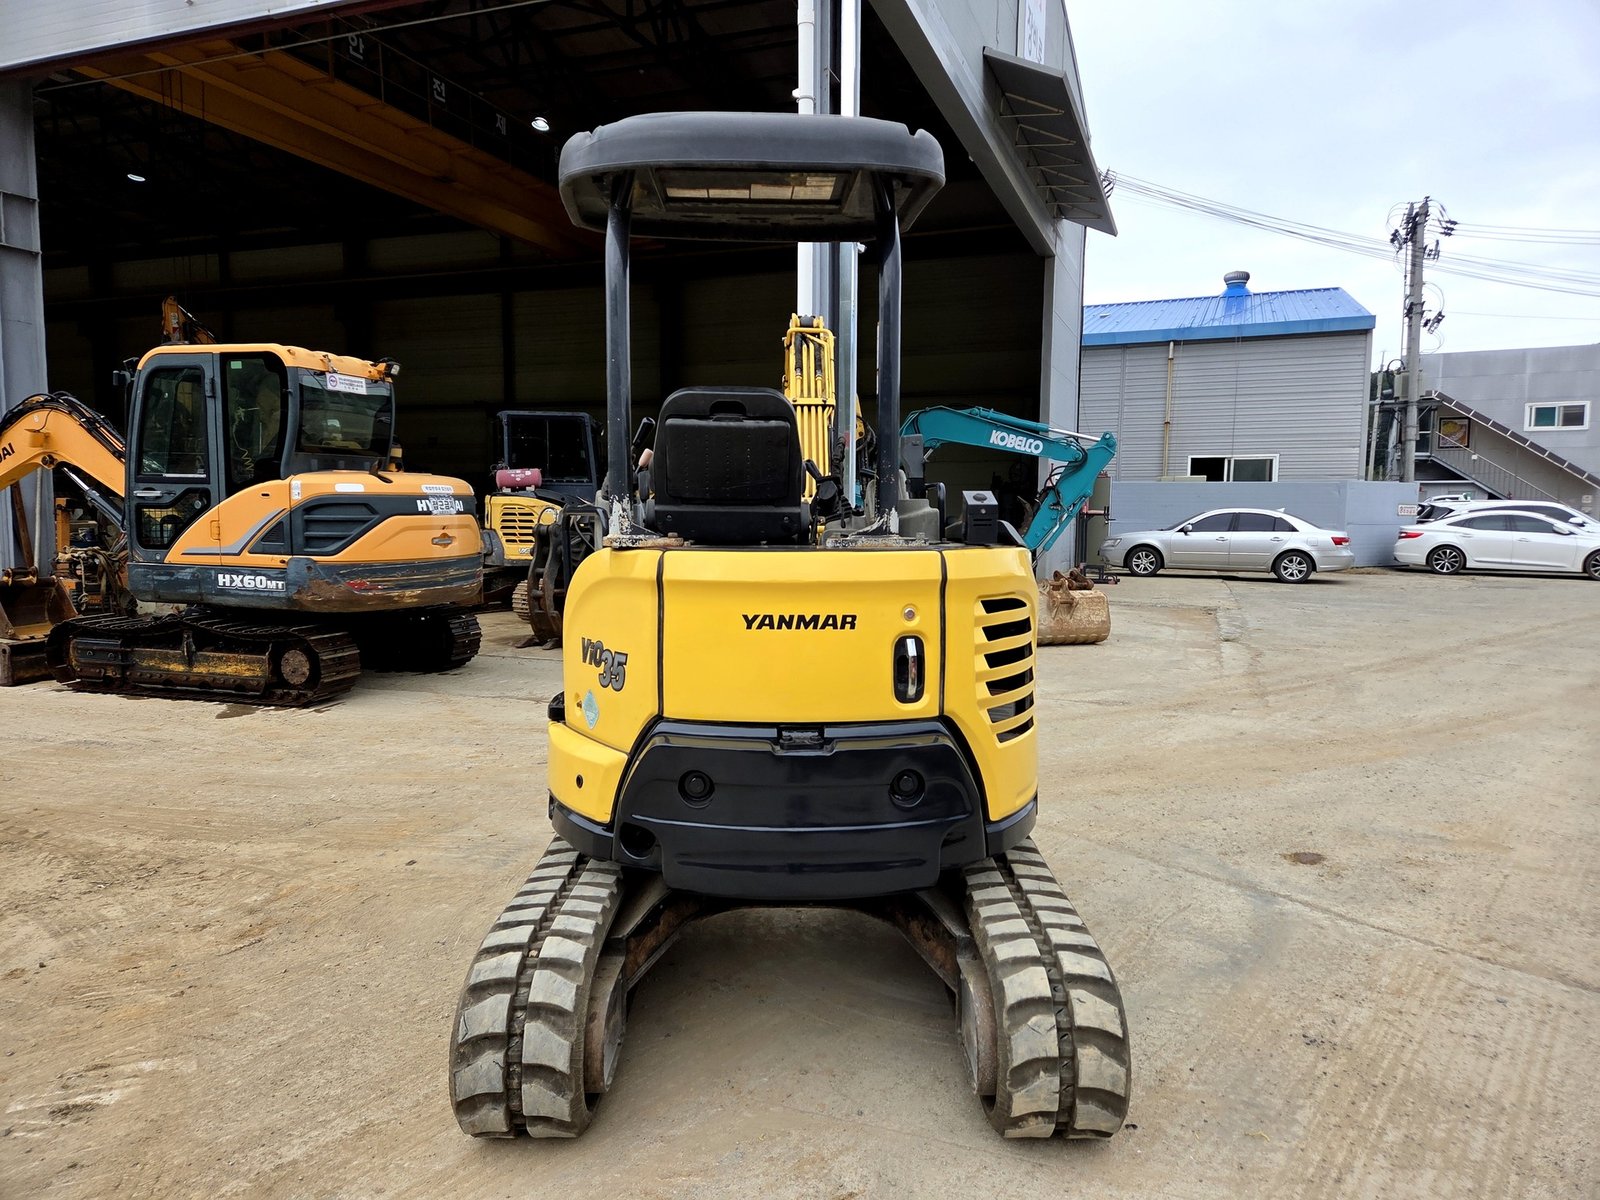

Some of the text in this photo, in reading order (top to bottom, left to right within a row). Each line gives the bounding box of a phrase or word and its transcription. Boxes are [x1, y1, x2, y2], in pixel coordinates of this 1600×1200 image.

[989, 430, 1044, 455] KOBELCO
[217, 573, 286, 592] HX60MT
[742, 614, 857, 630] YANMAR
